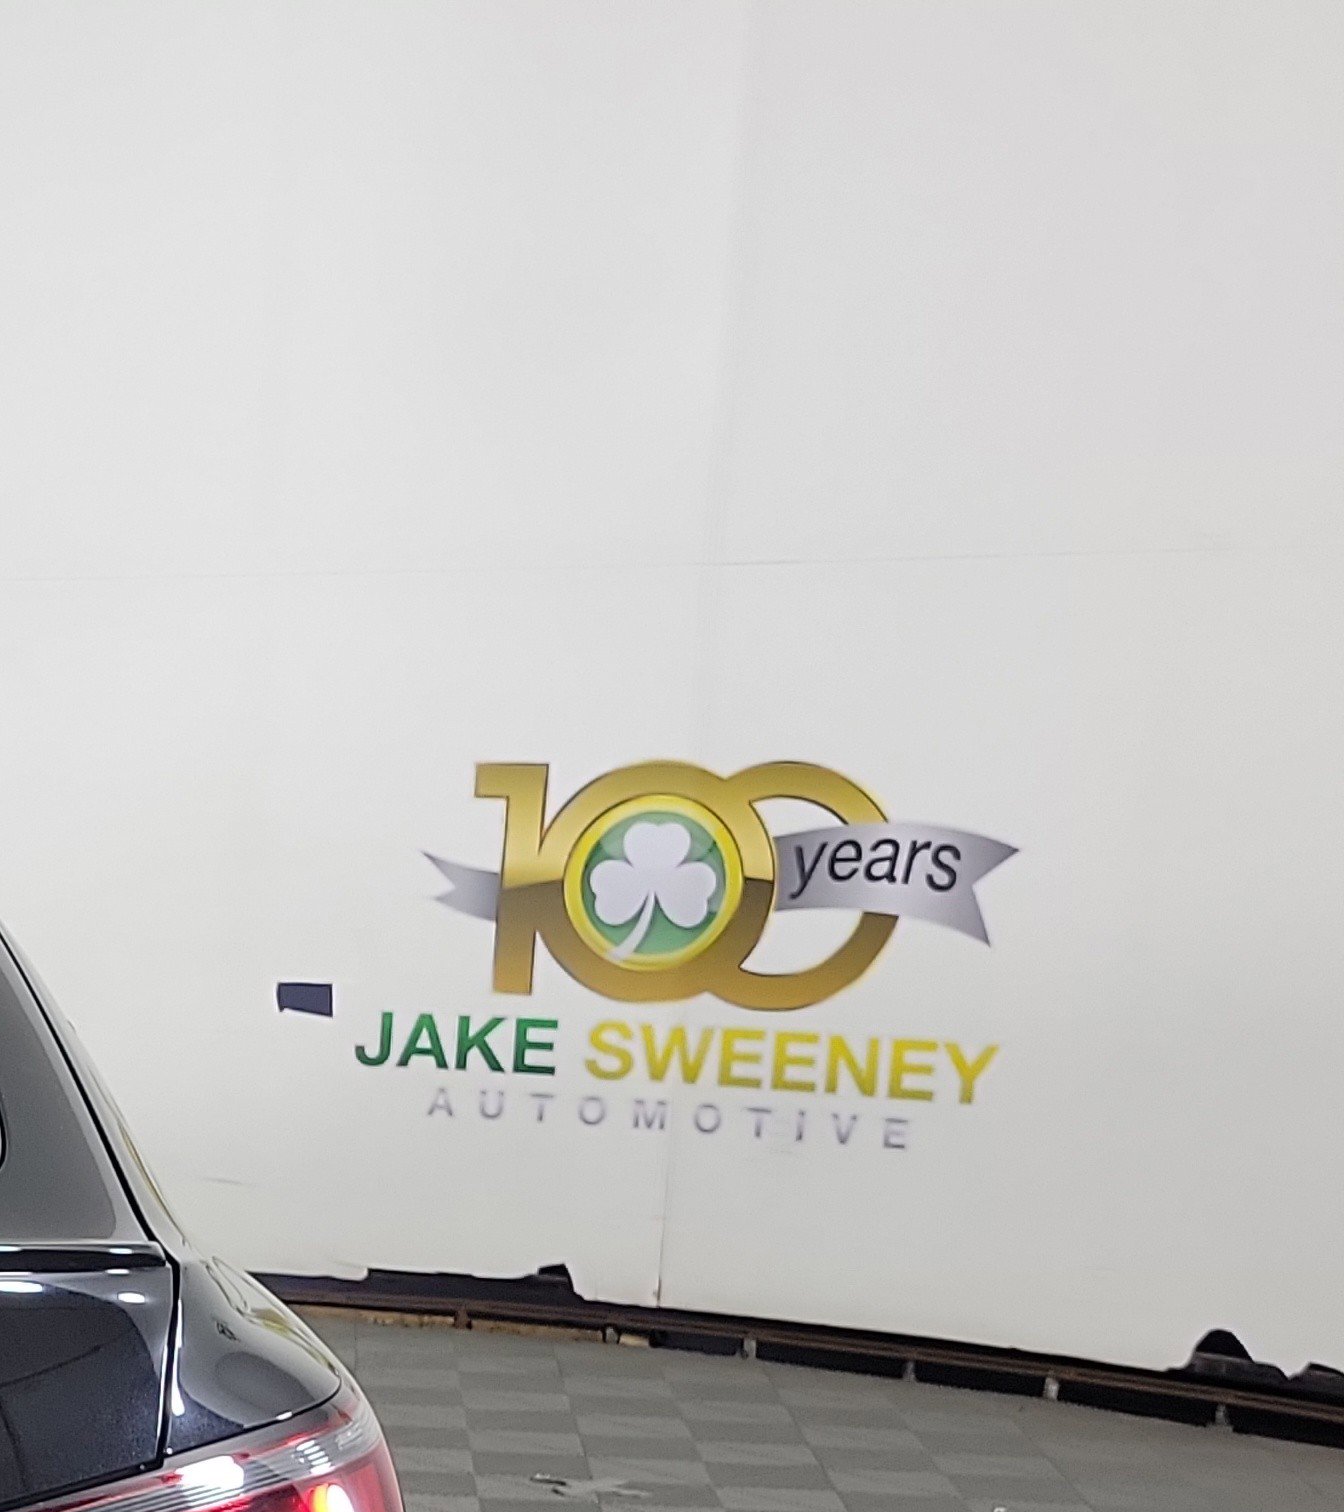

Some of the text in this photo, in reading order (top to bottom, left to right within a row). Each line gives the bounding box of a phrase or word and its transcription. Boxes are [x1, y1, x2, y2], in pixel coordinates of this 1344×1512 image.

[789, 835, 963, 900] years
[354, 1012, 1000, 1105] JAKE SWEENEY
[427, 1087, 909, 1150] AUTOMOTIVE
